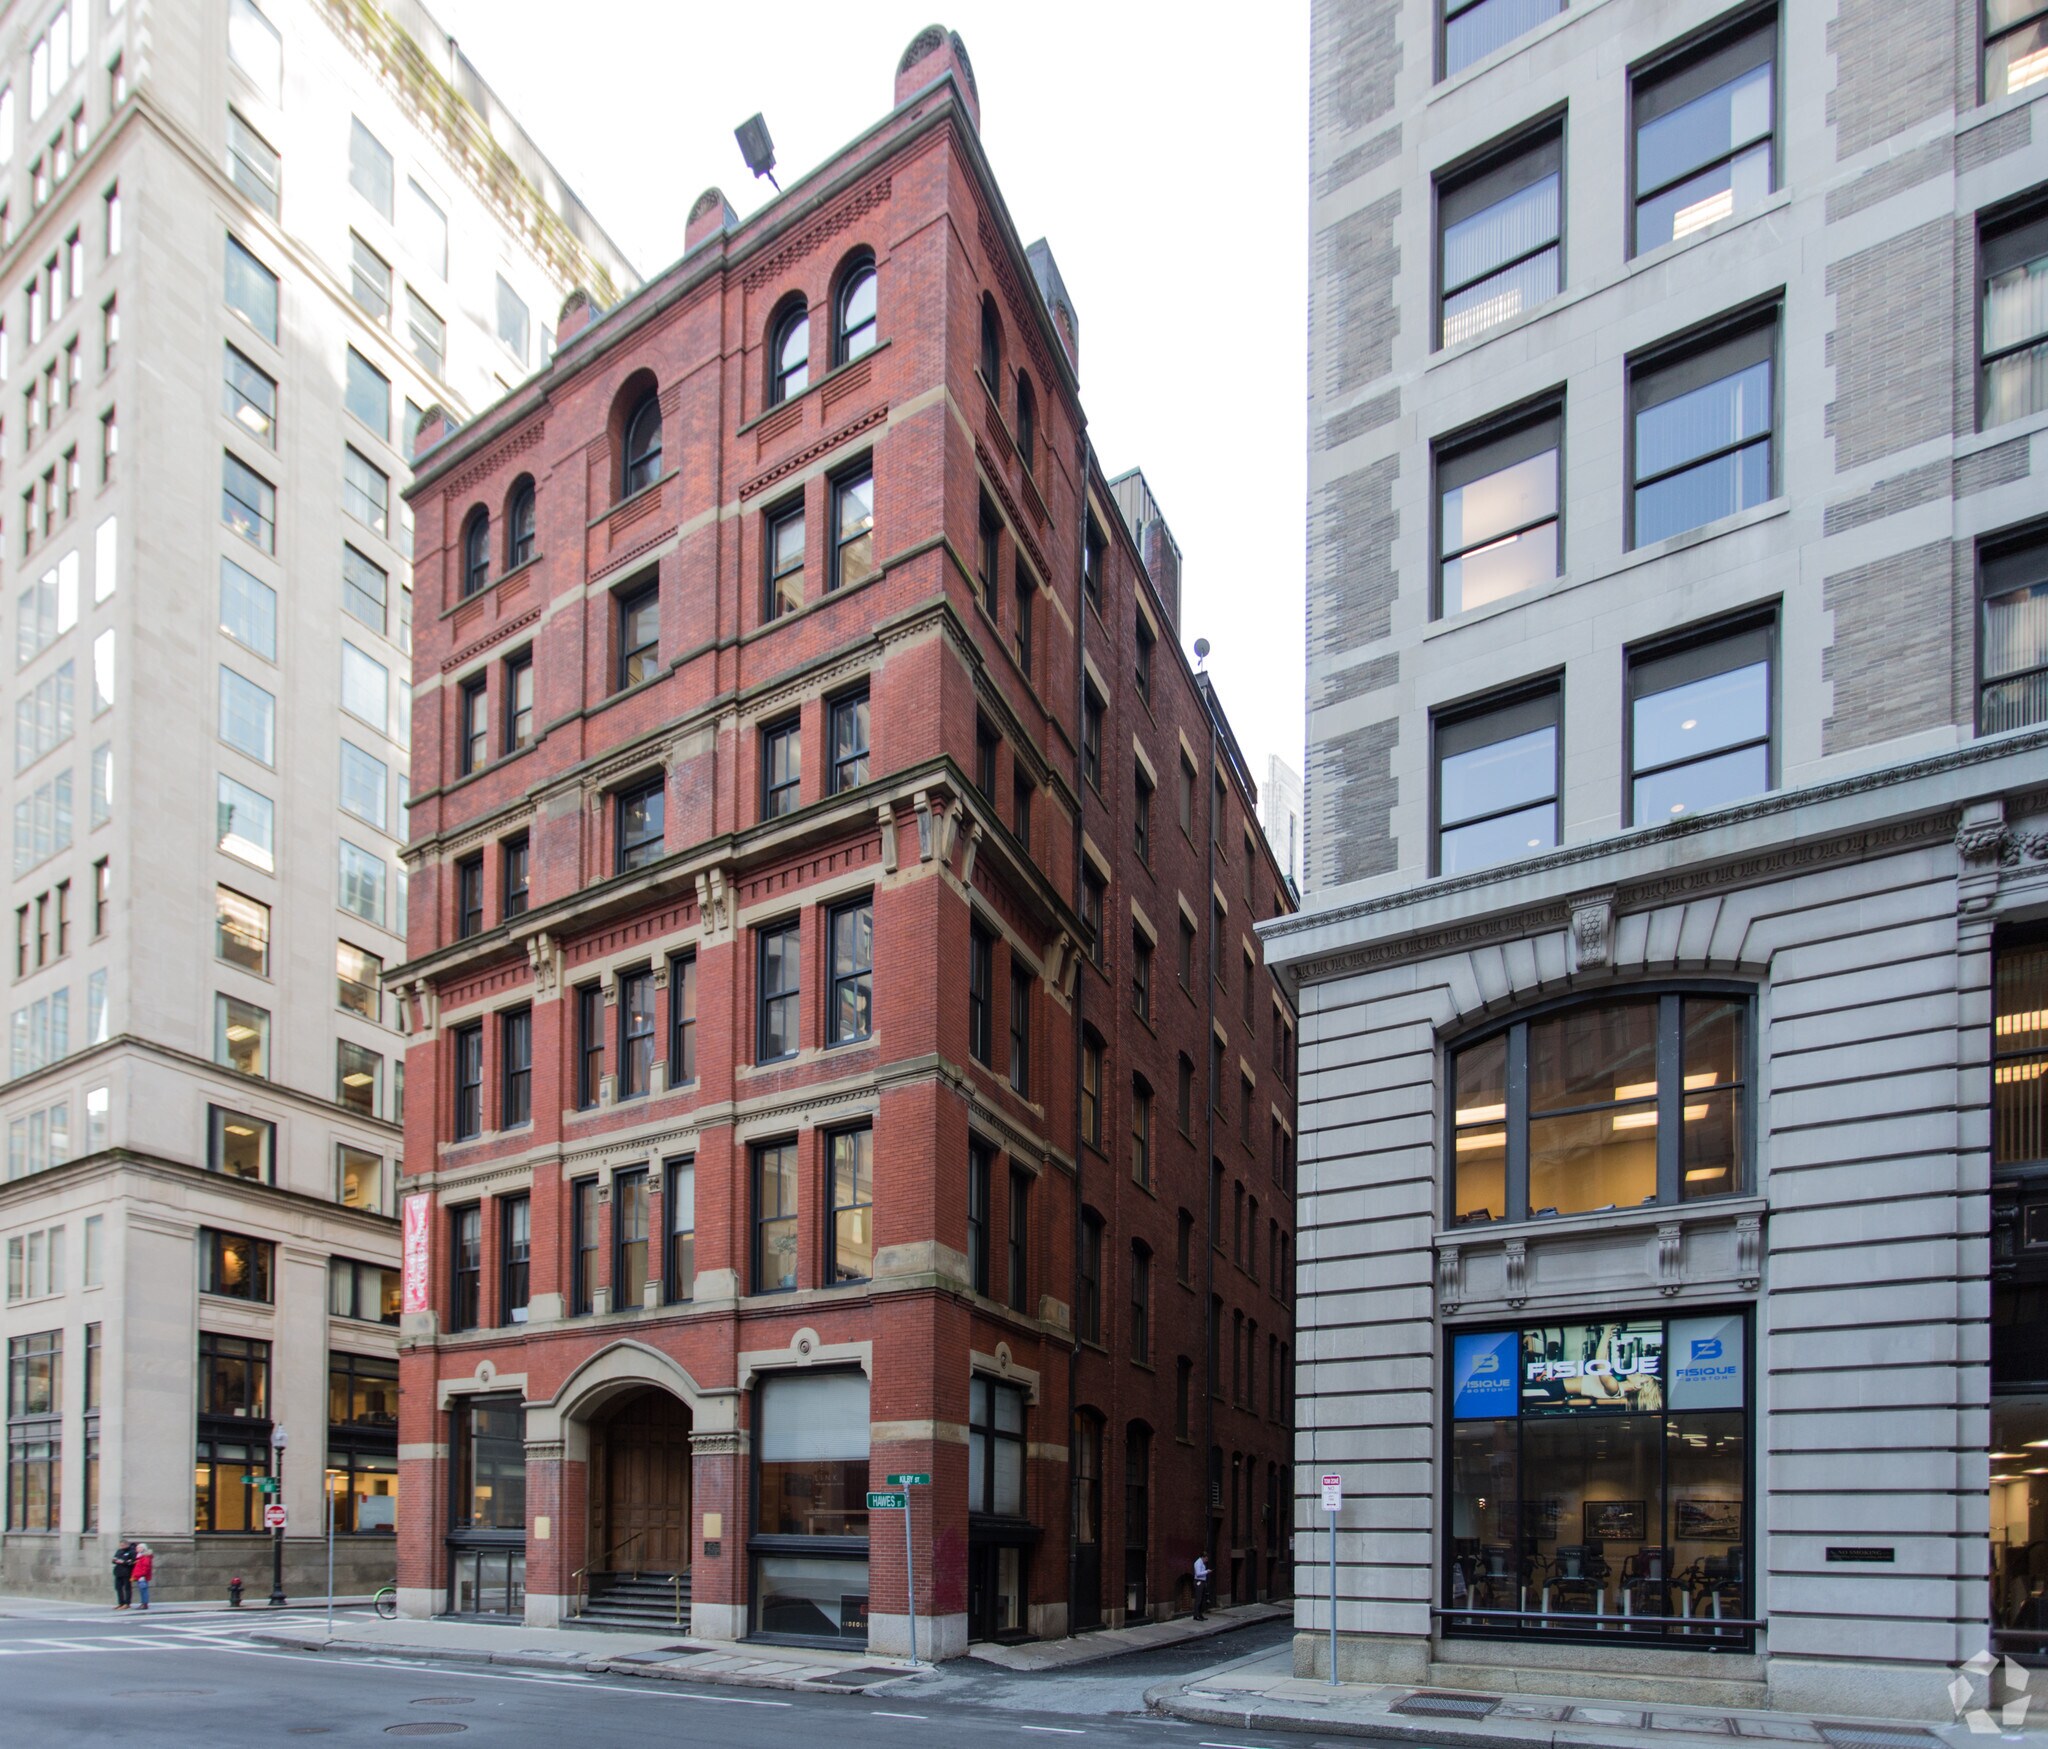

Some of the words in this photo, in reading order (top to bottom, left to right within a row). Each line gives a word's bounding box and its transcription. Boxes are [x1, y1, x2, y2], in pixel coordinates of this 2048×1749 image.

[1527, 1356, 1660, 1380] FISIQUE
[1676, 1366, 1737, 1378] FISIQUE
[899, 1475, 914, 1484] KILBY
[872, 1495, 896, 1507] HAWES
